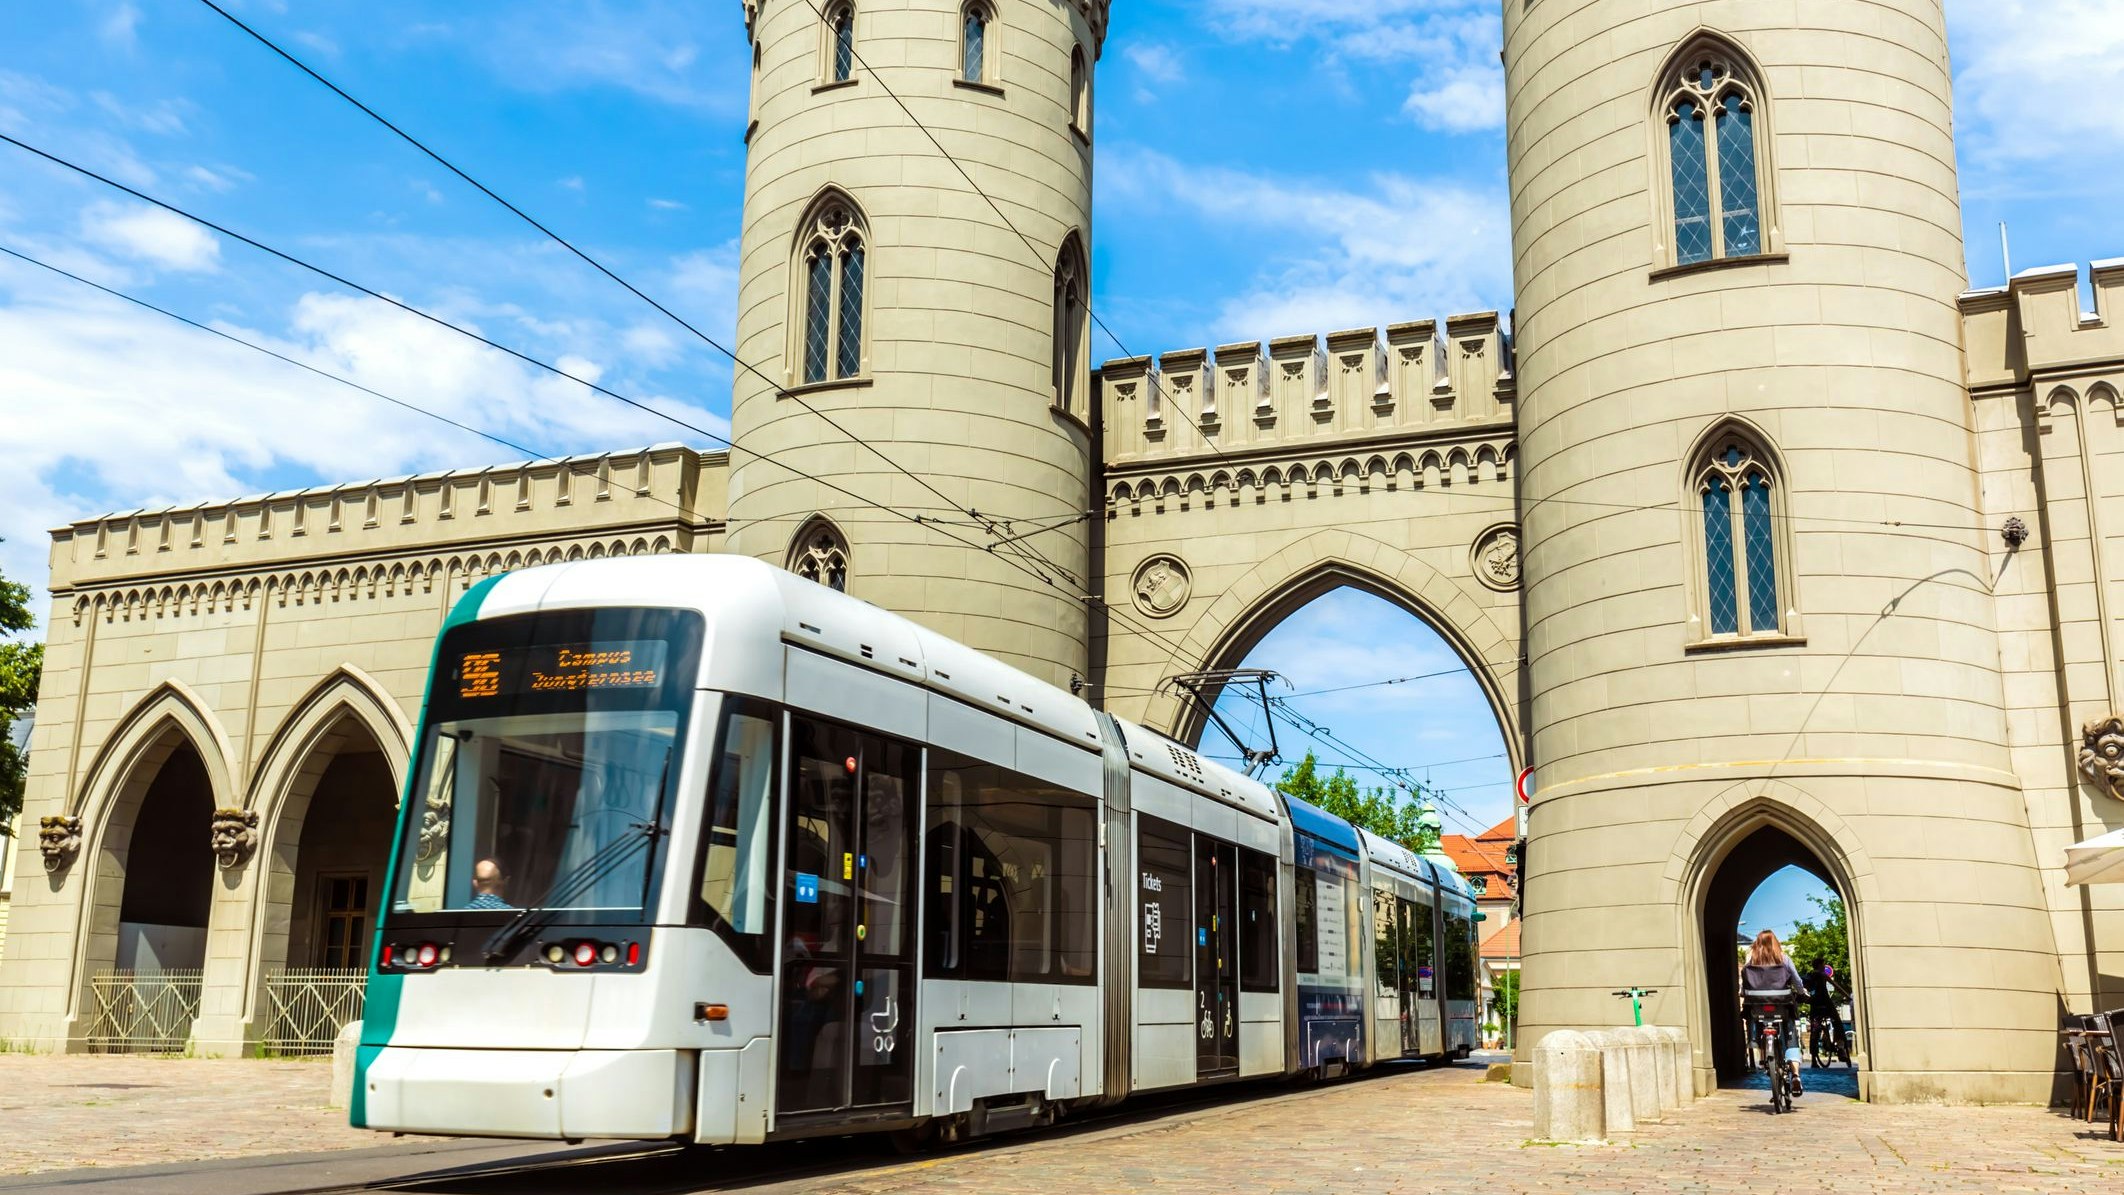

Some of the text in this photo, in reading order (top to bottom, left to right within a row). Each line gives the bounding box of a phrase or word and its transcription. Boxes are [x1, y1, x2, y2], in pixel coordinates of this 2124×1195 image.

[559, 650, 631, 667] Campus
[461, 653, 500, 697] 96
[1142, 872, 1162, 892] Tickets
